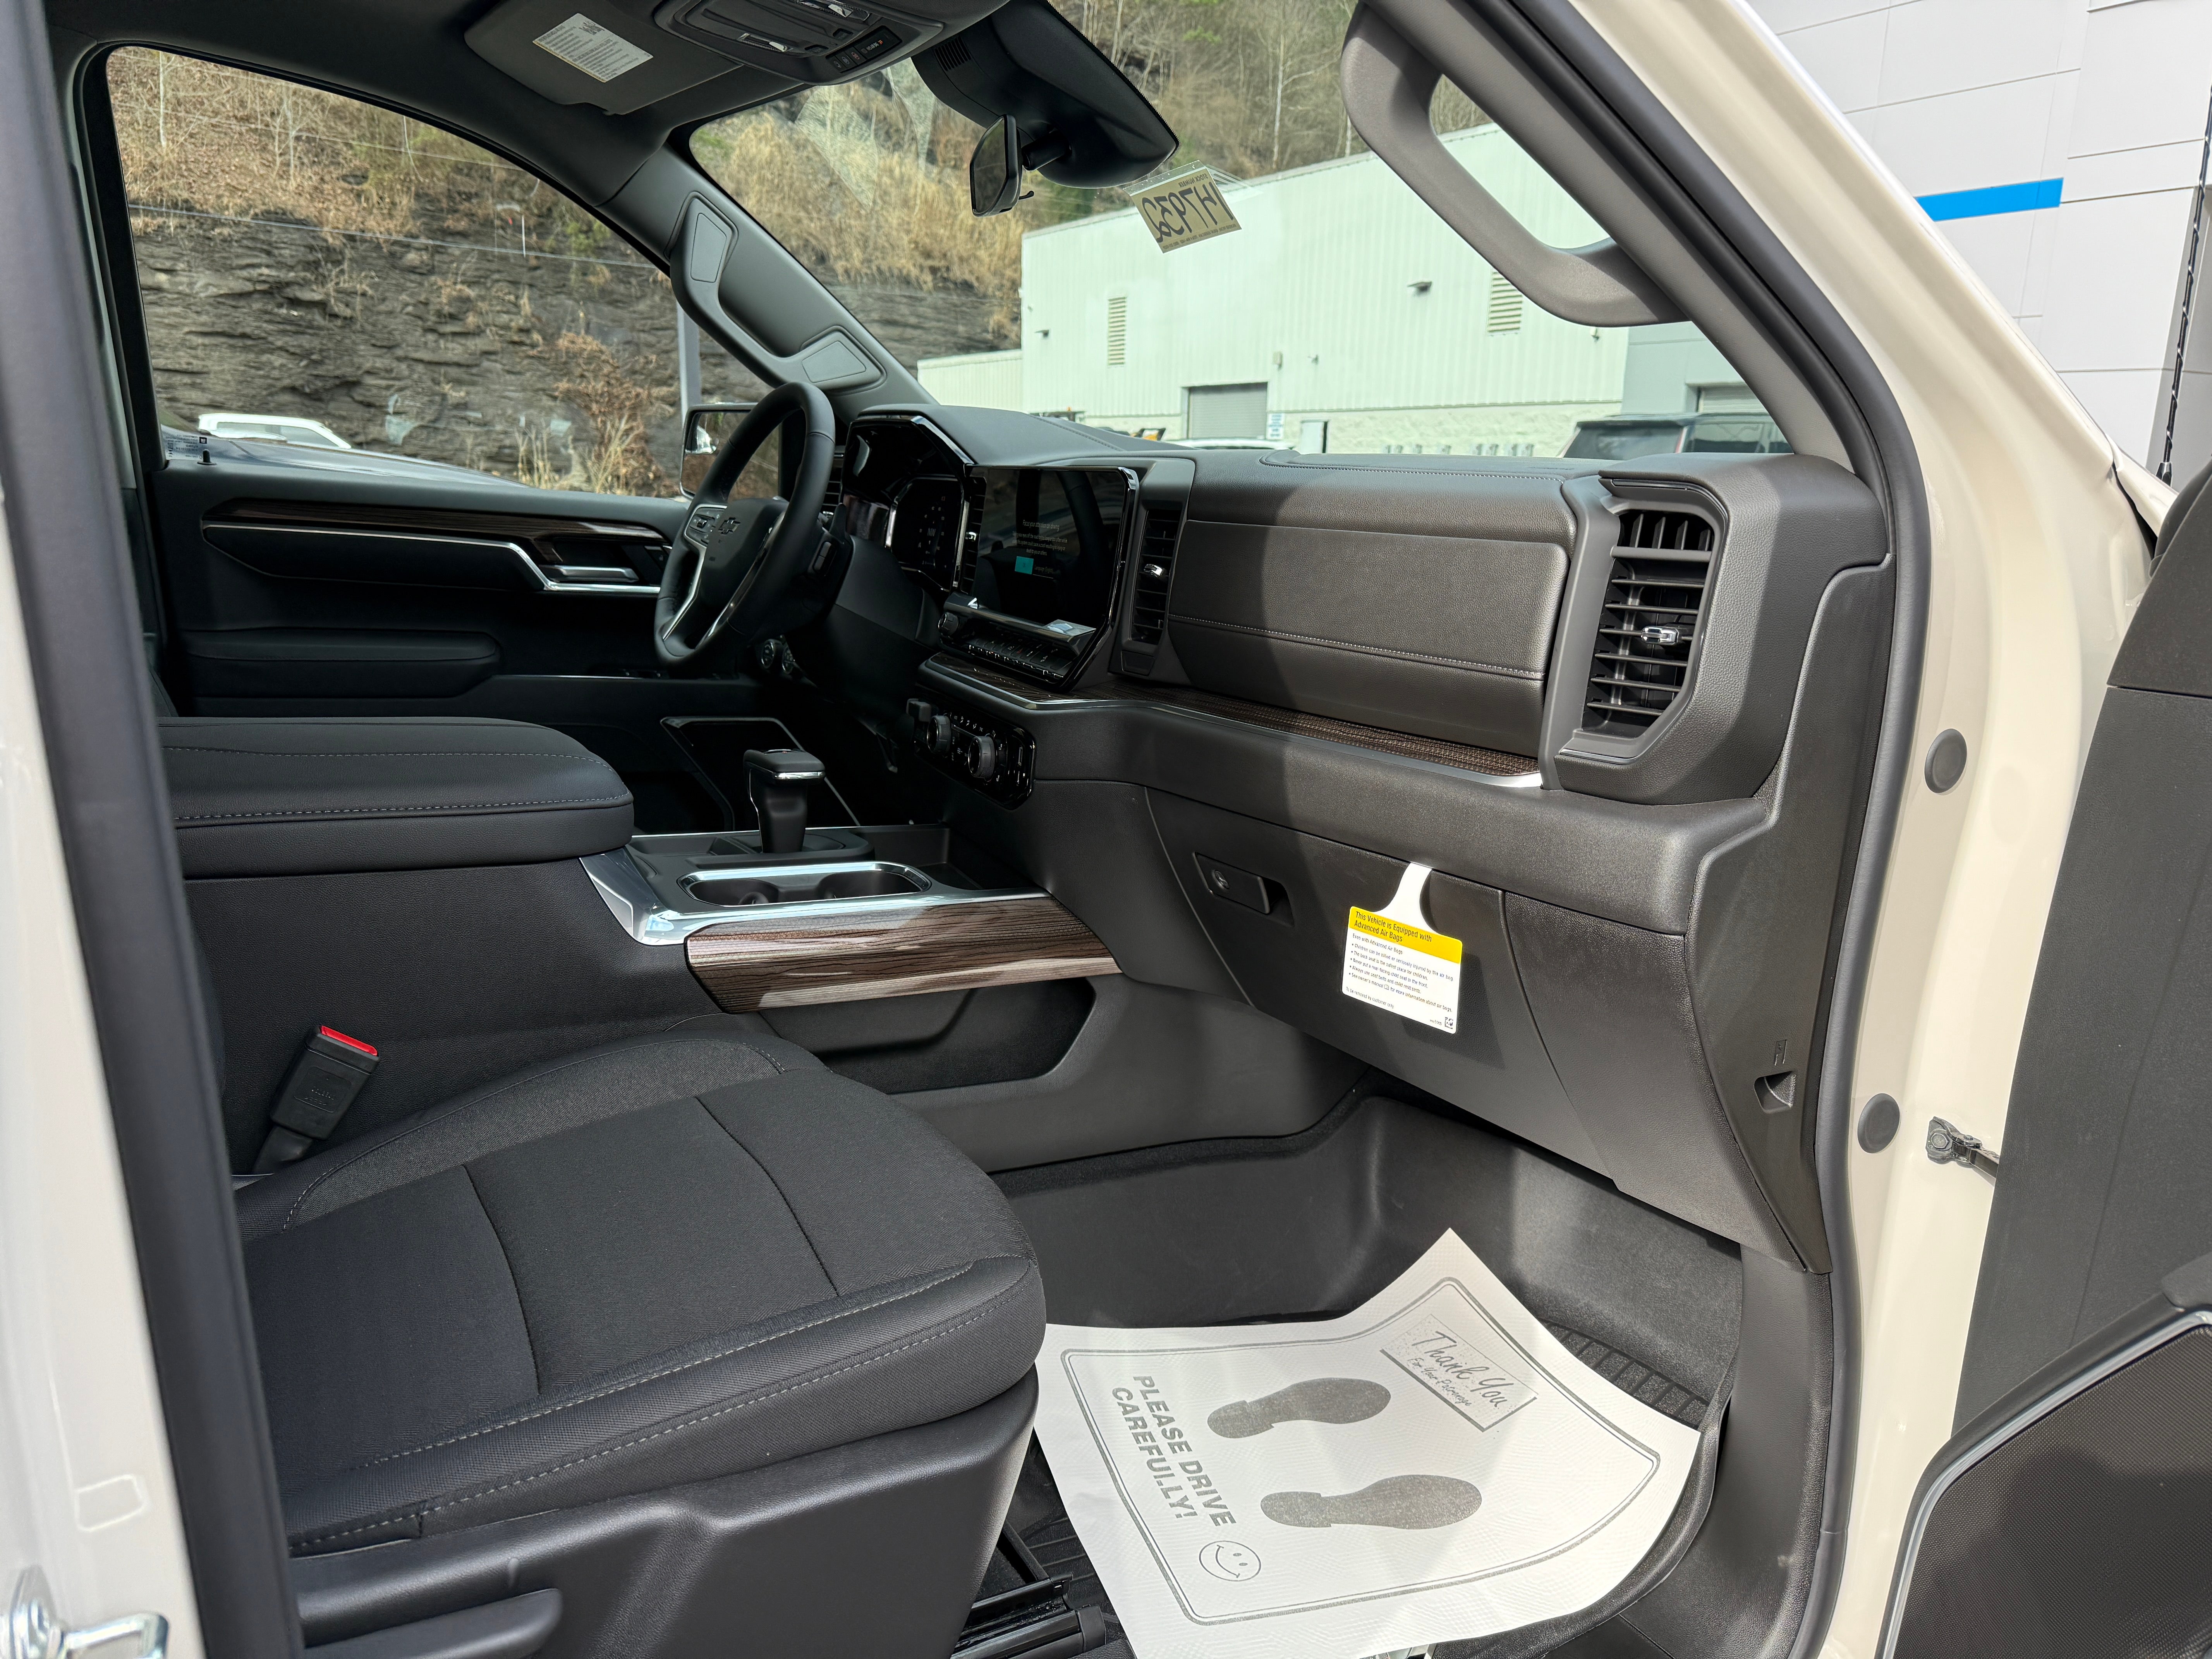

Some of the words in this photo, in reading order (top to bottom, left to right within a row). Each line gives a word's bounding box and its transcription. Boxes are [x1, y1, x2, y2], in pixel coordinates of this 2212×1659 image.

[1354, 920, 1379, 934] Advanced
[1389, 932, 1403, 942] Bags
[1356, 911, 1366, 921] This
[1367, 915, 1386, 927] Vehicle
[1393, 924, 1418, 937] Equipped
[1420, 933, 1432, 942] with
[1408, 1357, 1424, 1368] For
[1421, 1367, 1438, 1380] Your
[1436, 1379, 1472, 1407] Patronage
[1412, 1331, 1490, 1379] Thank
[1470, 1377, 1514, 1408] You
[1111, 1387, 1198, 1518] CAREFULLY!
[1133, 1376, 1193, 1454] PLEASE
[1178, 1460, 1237, 1527] DRIVE
